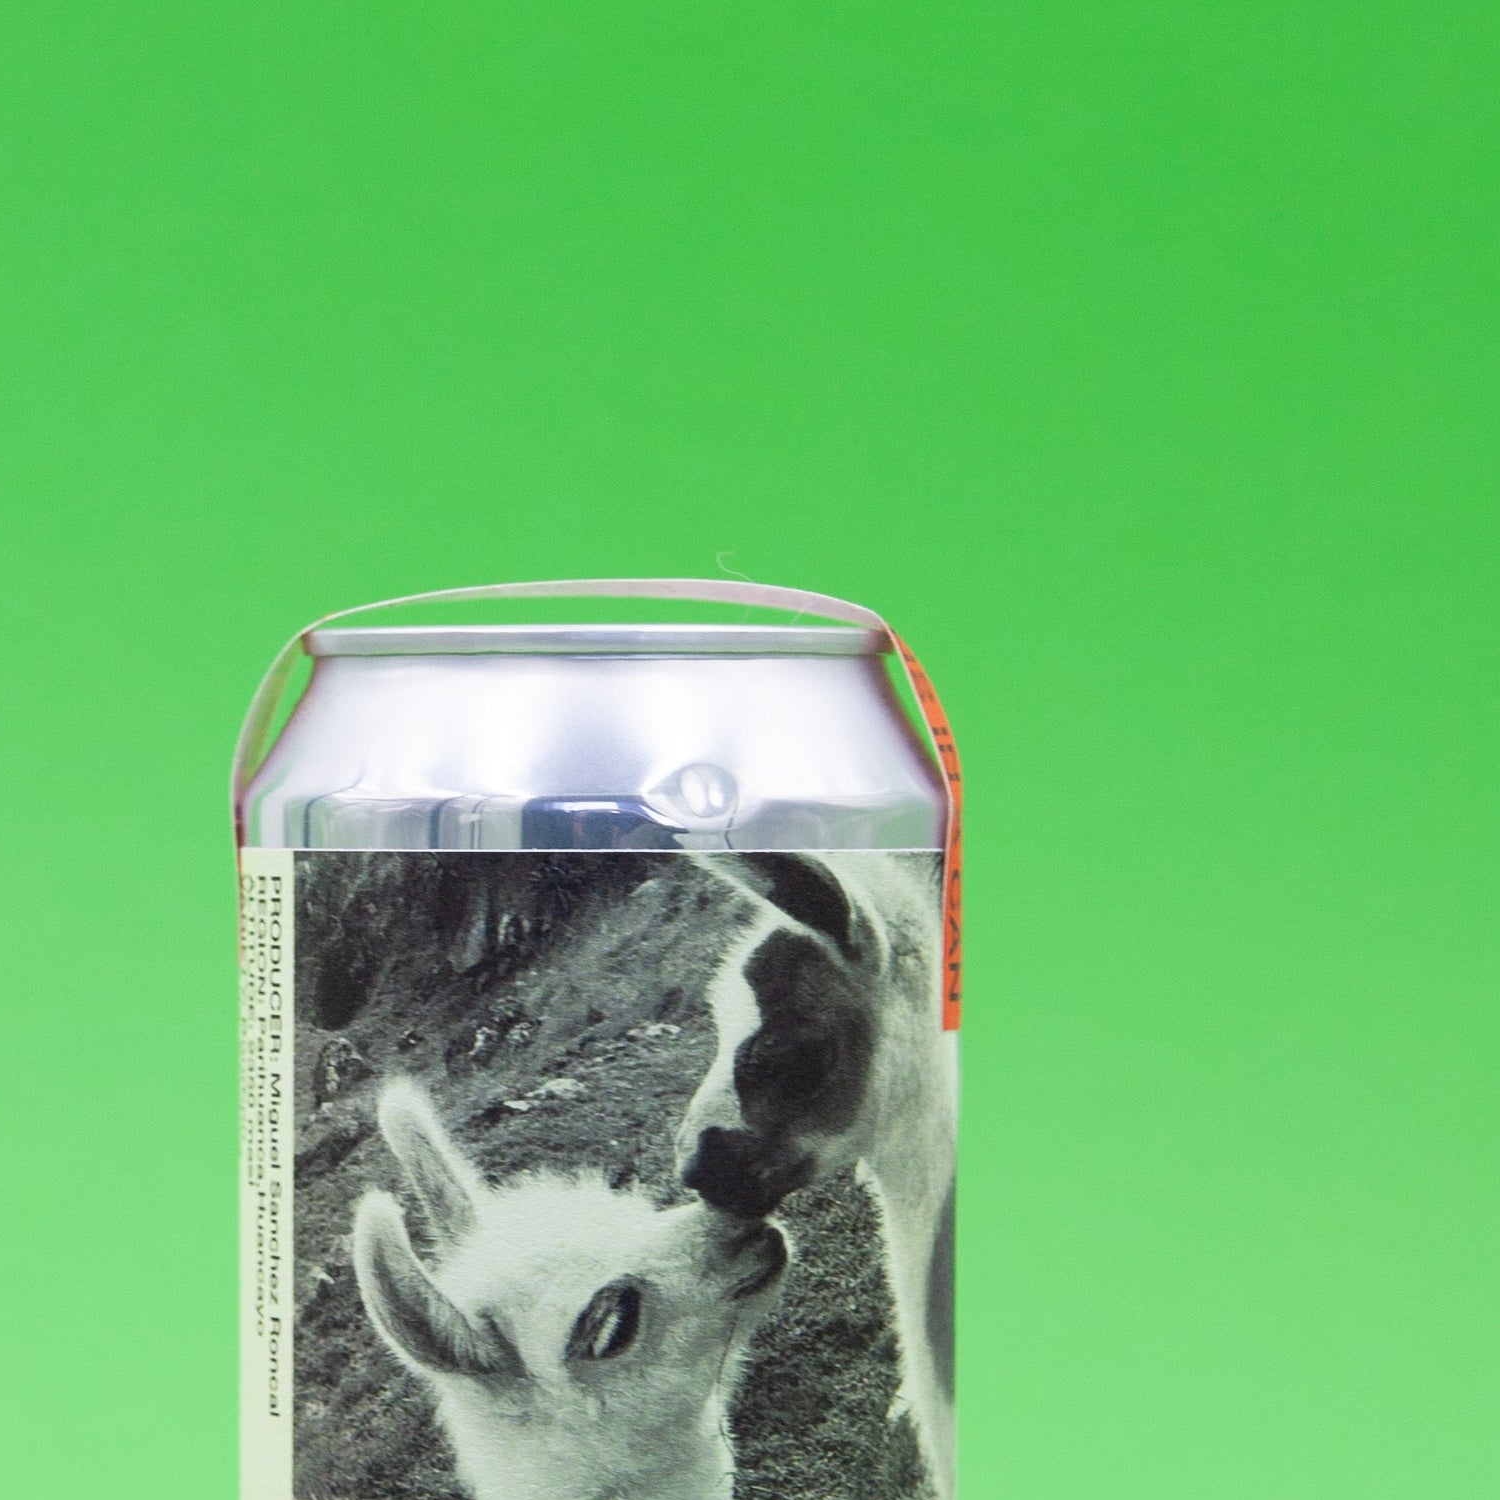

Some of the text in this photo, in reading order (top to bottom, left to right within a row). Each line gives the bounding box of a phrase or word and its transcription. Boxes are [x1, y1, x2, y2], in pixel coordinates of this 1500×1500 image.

[268, 875, 283, 1418] PRODUCER: Miguel Sanchez Roncal
